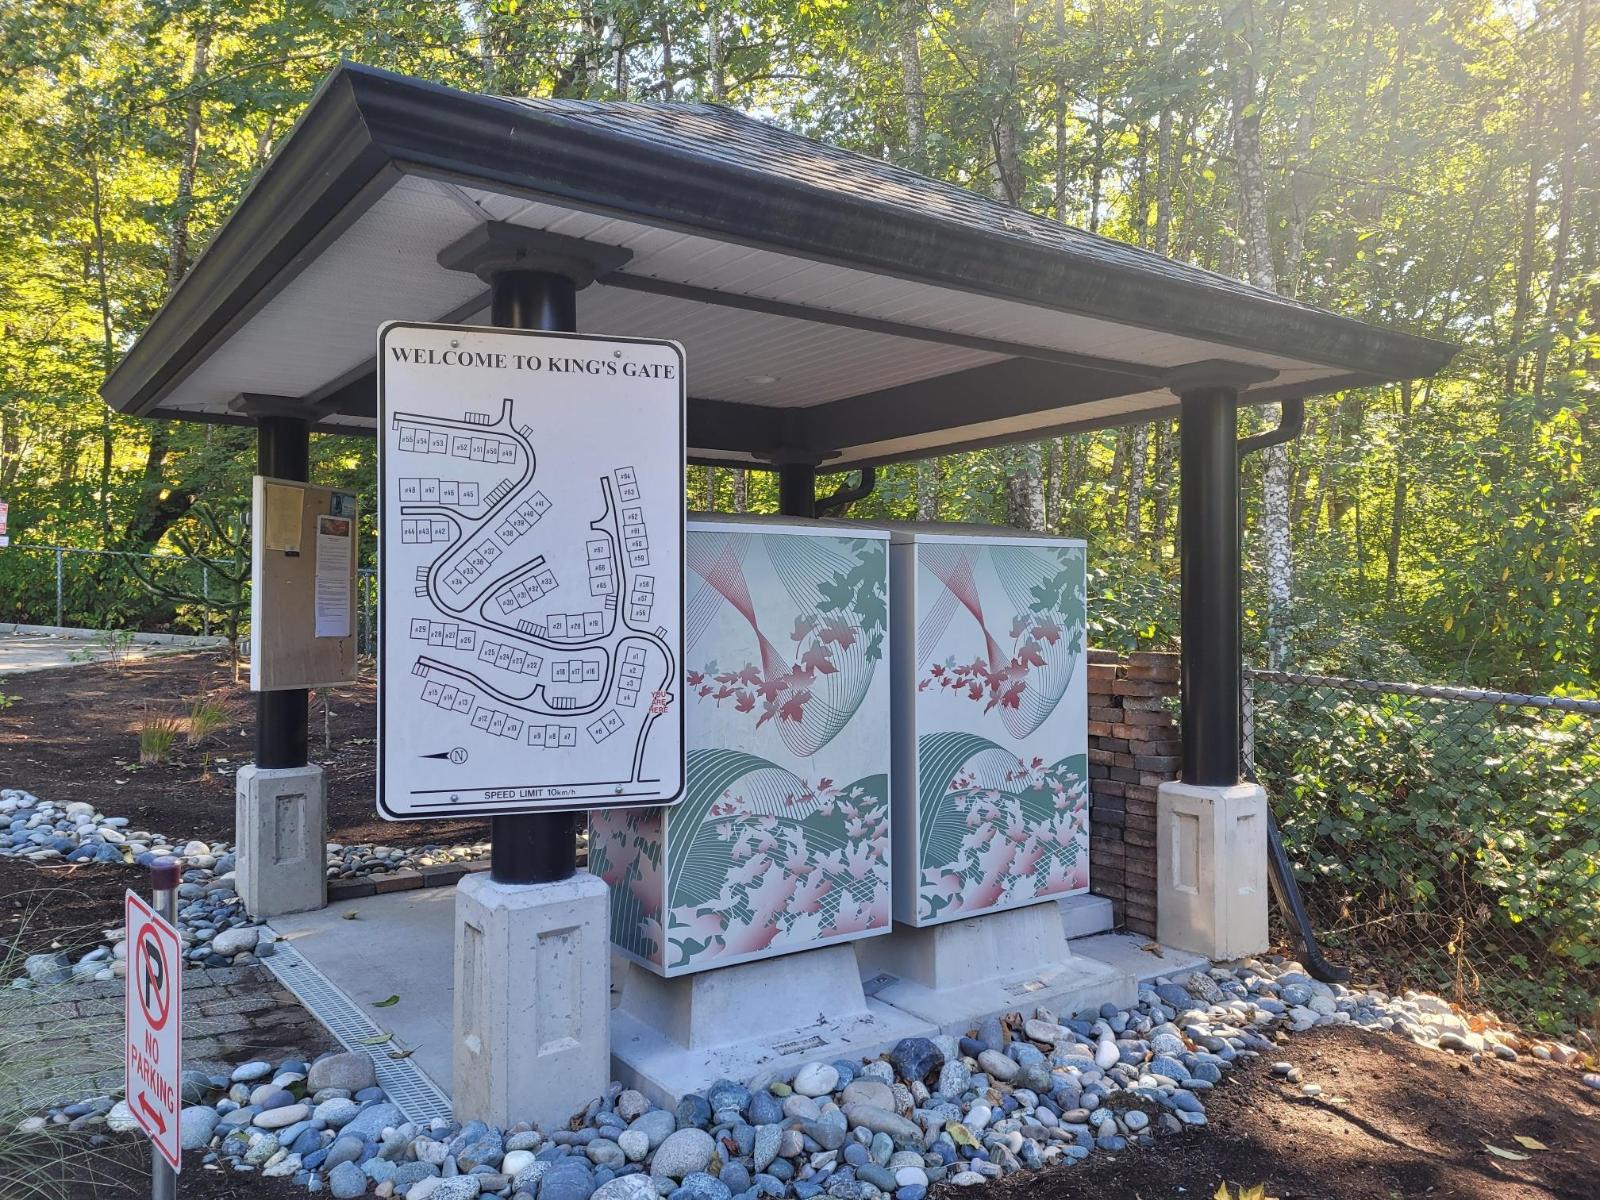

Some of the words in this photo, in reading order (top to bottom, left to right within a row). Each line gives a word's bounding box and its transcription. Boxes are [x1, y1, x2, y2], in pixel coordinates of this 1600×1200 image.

[391, 347, 508, 369] WELCOME
[513, 354, 541, 371] TO
[548, 357, 617, 376] KING'S
[622, 361, 675, 380] GATE
[649, 706, 669, 714] HERE
[454, 750, 463, 762] N
[484, 790, 516, 800] SPEED
[520, 789, 543, 798] LIMIT
[548, 788, 576, 797] 10km/h
[145, 1029, 159, 1064] NO
[131, 1044, 174, 1114] PARKING
